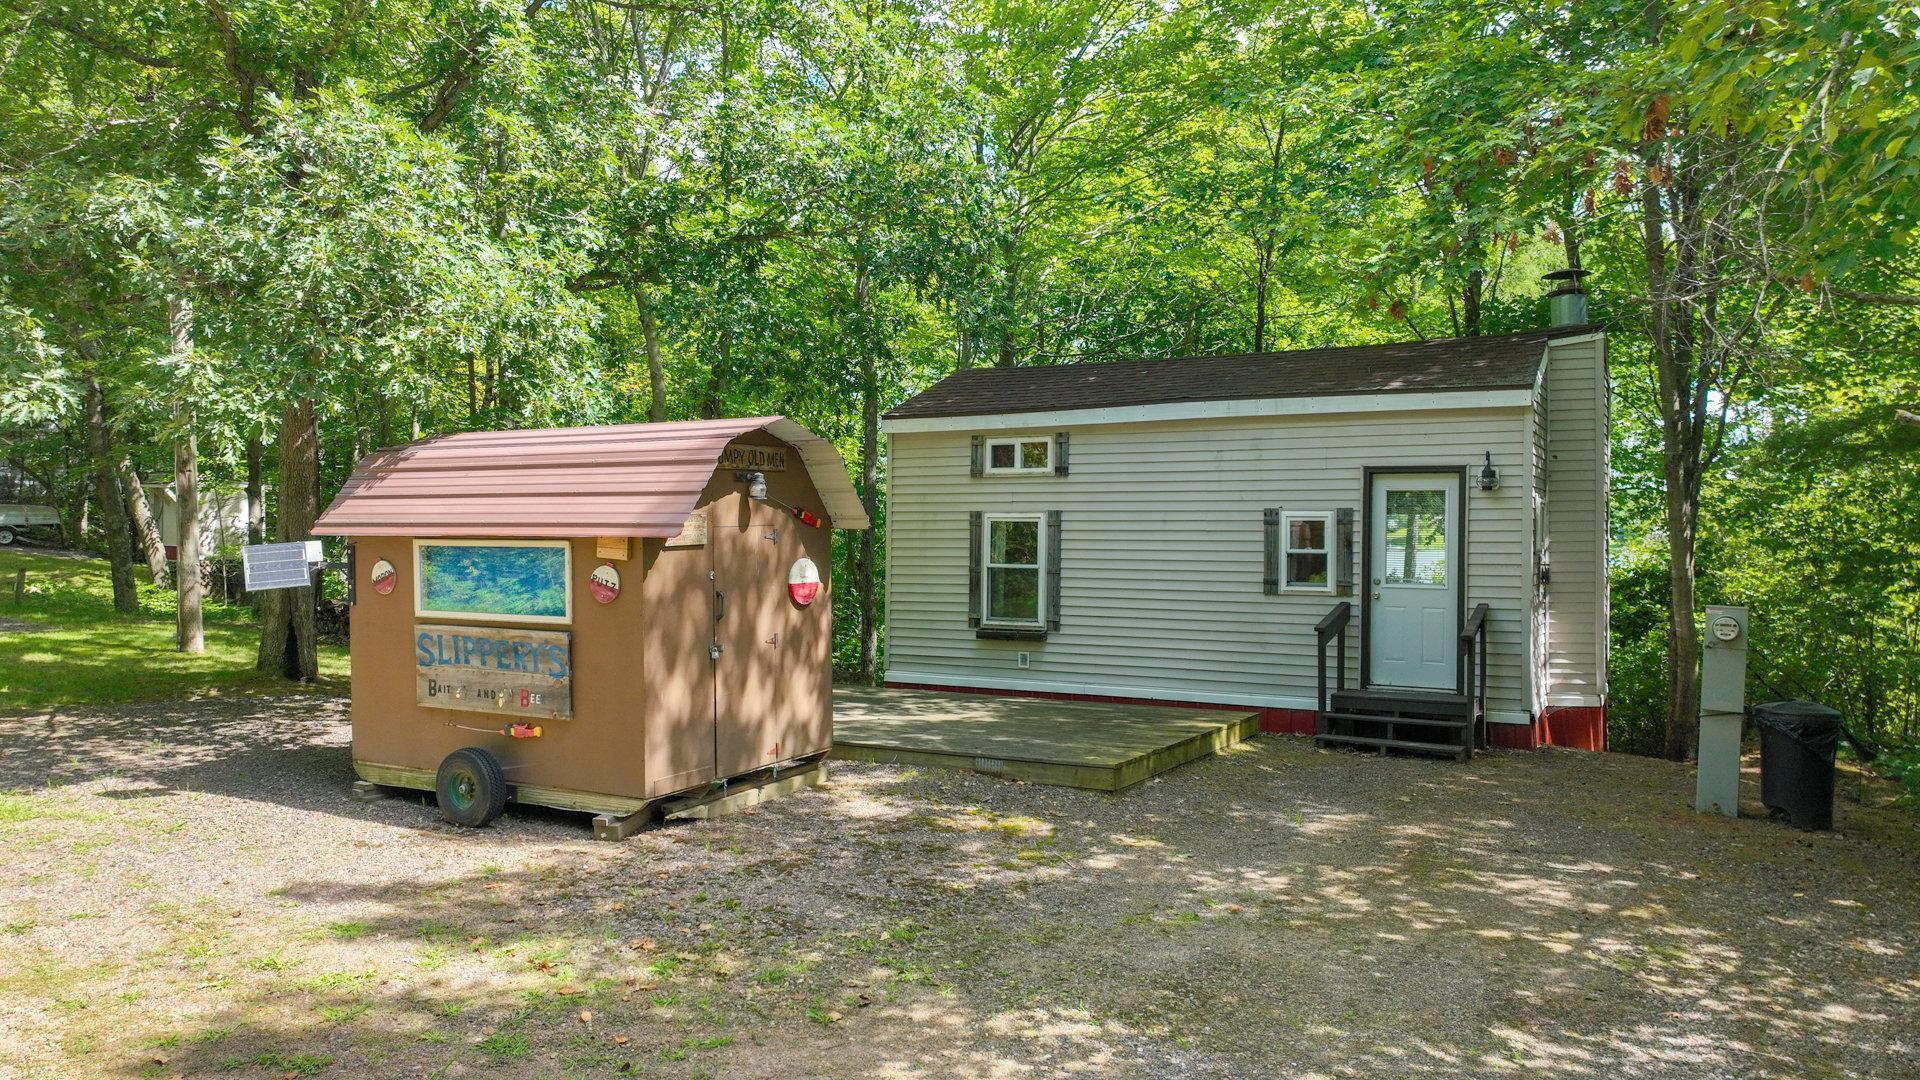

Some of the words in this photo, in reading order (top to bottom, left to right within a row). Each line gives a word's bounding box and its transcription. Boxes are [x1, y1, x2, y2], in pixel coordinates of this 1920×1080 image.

[747, 450, 765, 466] OLD
[767, 452, 785, 468] MEN
[592, 573, 618, 592] PUTZ
[416, 632, 568, 680] SLIPPERY'S
[428, 679, 451, 697] BAIT
[476, 689, 496, 700] AND
